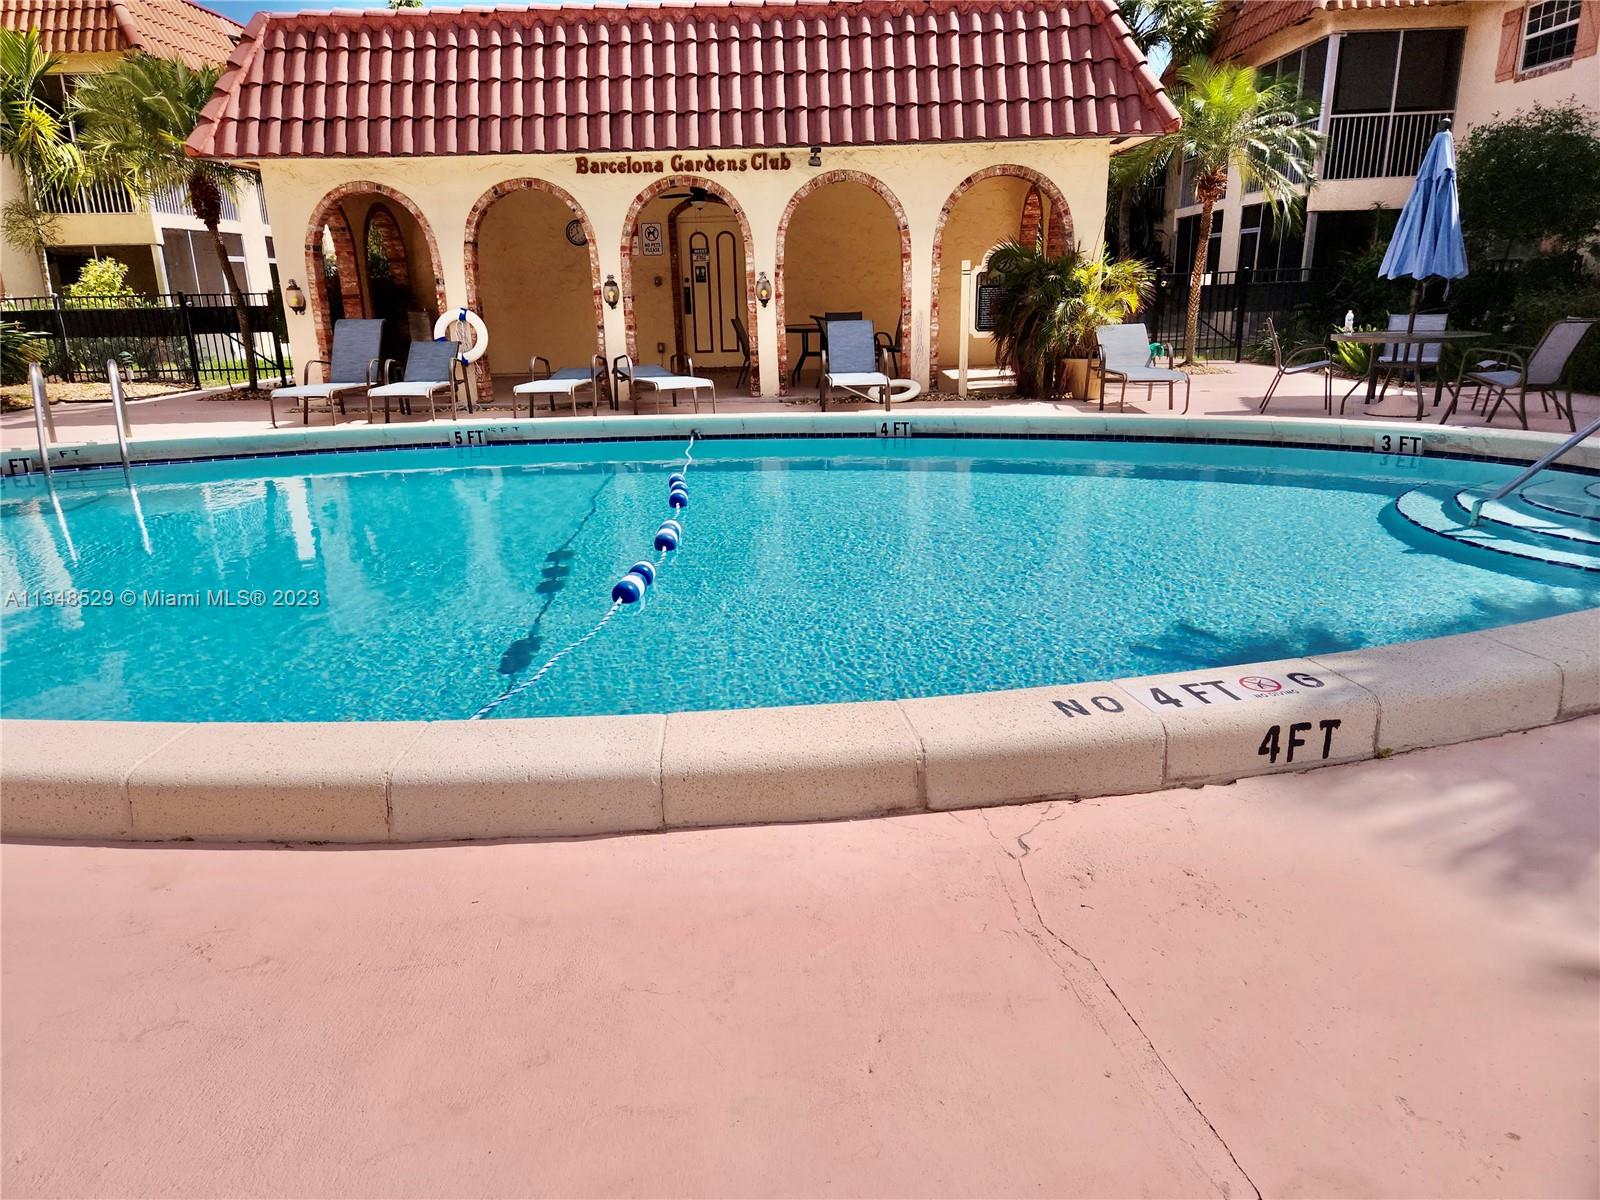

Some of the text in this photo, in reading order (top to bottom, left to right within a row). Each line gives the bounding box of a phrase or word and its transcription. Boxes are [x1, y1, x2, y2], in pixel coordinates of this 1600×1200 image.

[575, 152, 791, 174] Barcelona Gardens Club
[454, 430, 484, 445] 5 FT
[880, 421, 910, 436] 4 FT
[1381, 434, 1392, 452] 3
[1399, 435, 1422, 454] FT
[1052, 695, 1125, 718] NO
